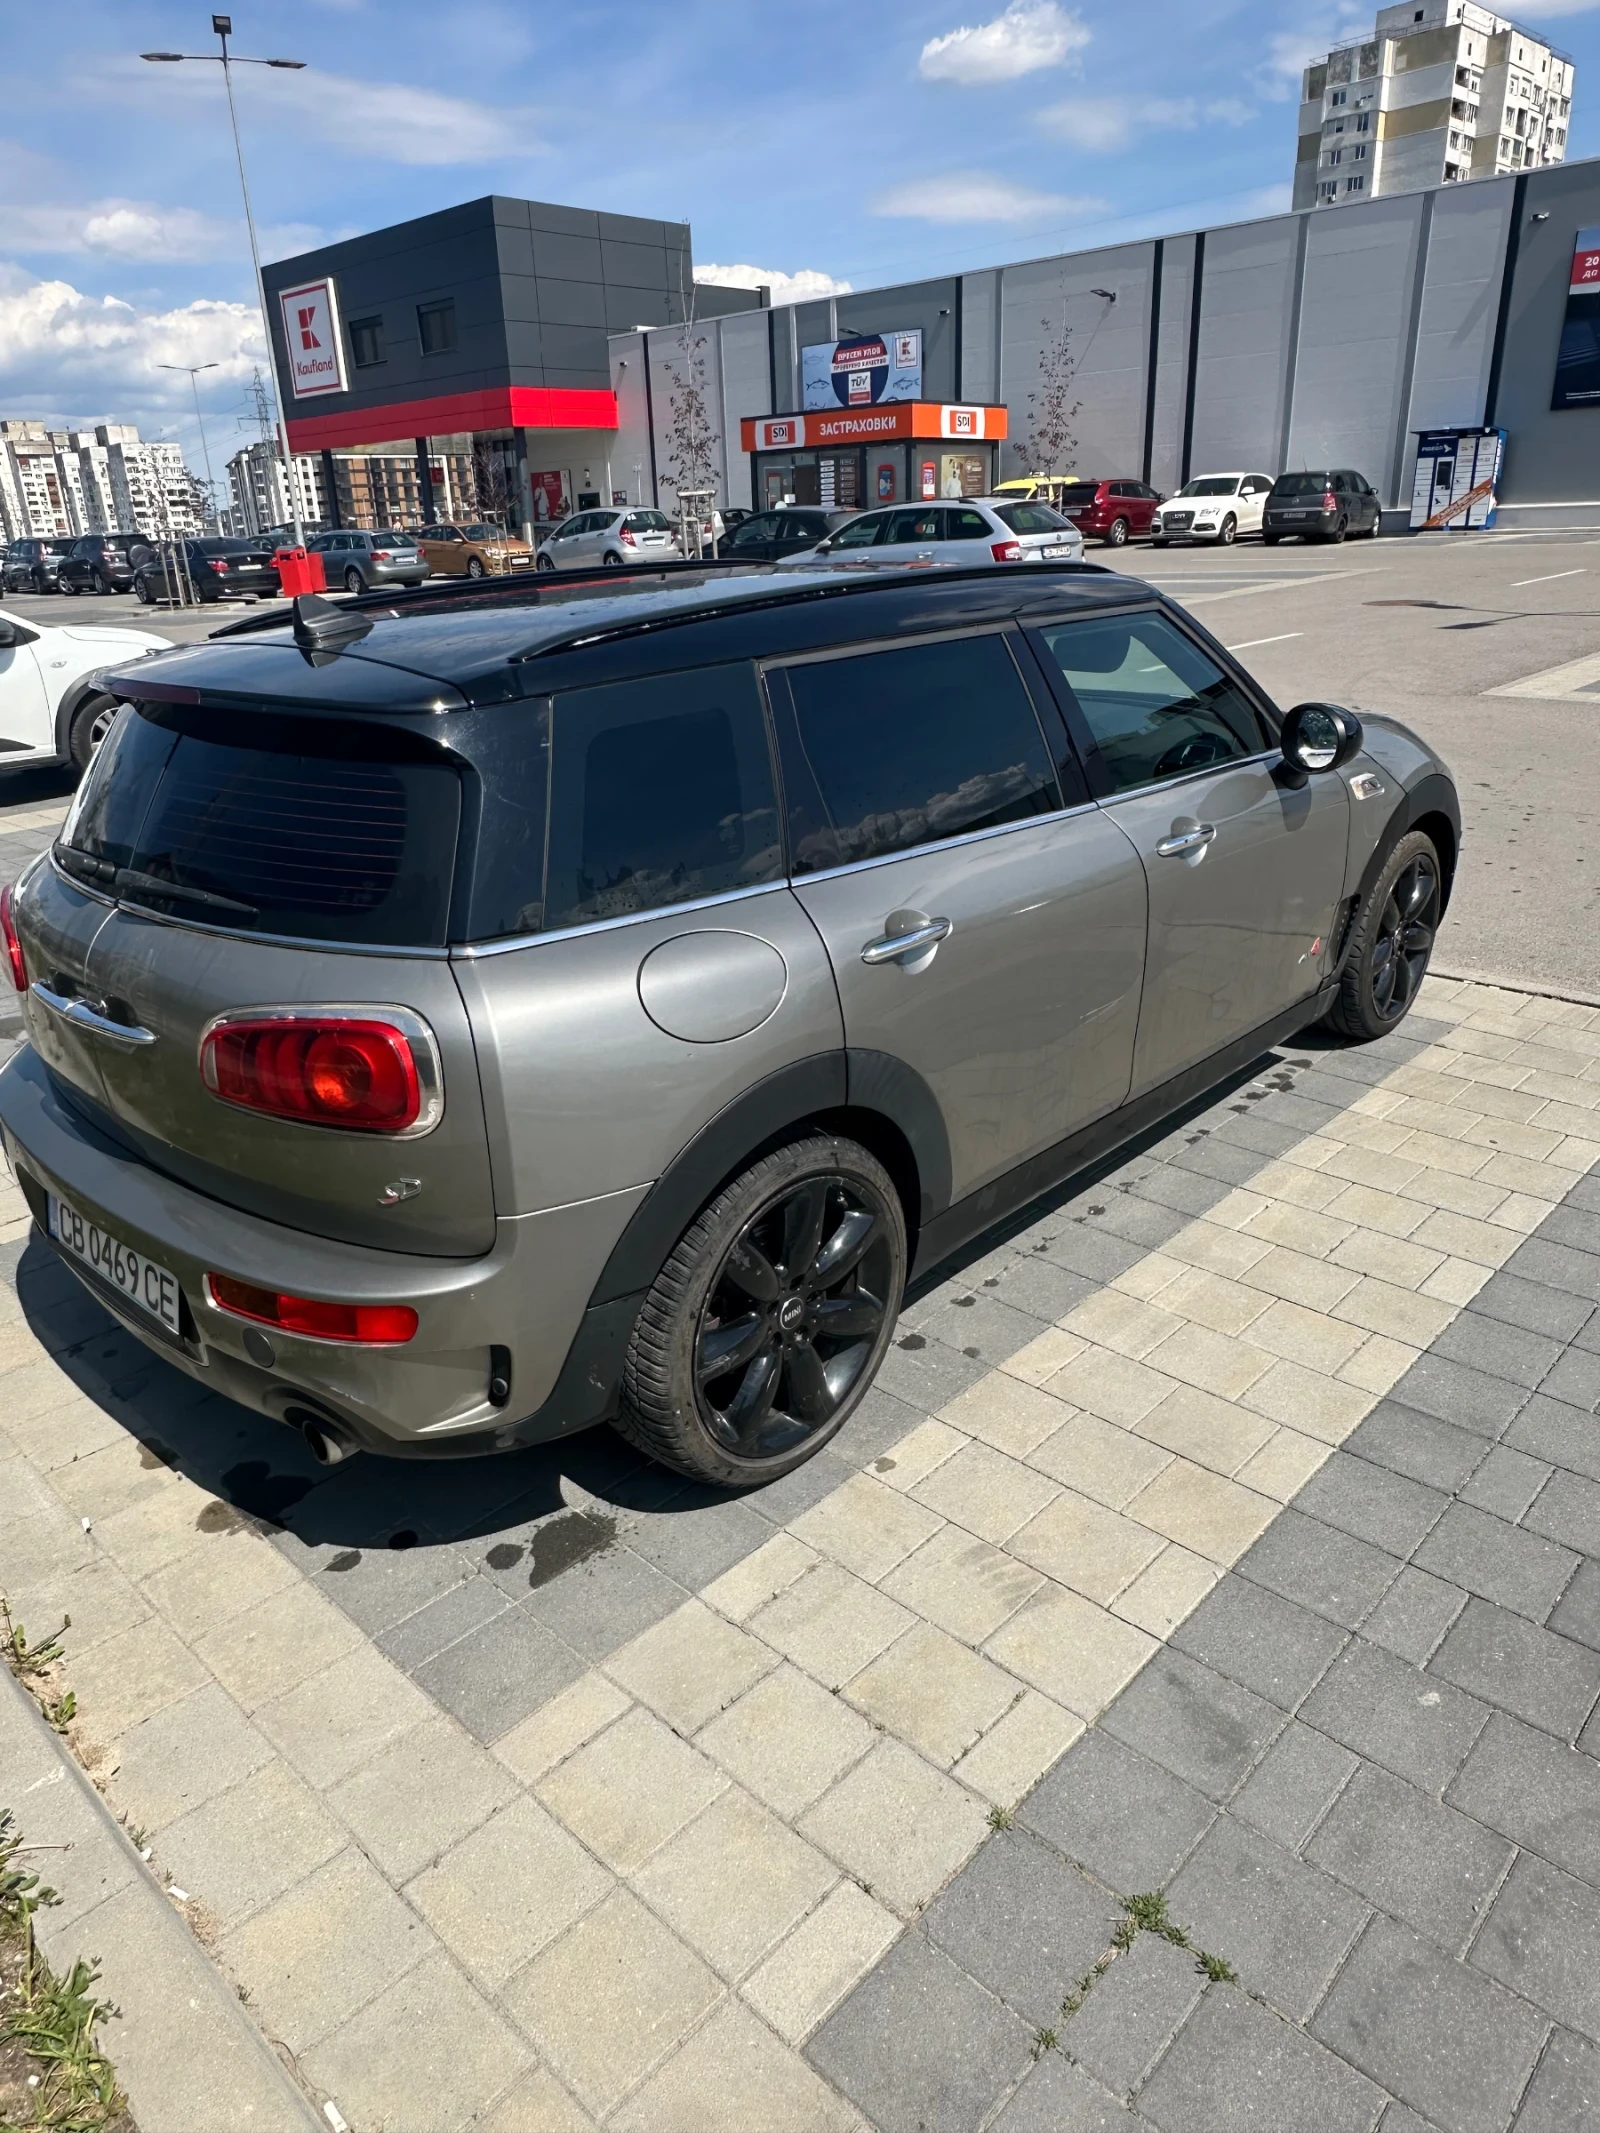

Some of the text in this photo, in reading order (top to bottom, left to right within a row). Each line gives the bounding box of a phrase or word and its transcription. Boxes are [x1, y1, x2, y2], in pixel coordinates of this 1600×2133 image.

[298, 305, 321, 350] K
[297, 356, 333, 376] Kaufland
[851, 375, 868, 387] TÜV
[819, 415, 896, 436] ЗАСТРАХОВКИ
[956, 414, 970, 427] SDI
[772, 426, 787, 438] SDI
[60, 1203, 174, 1325] CB 0469 CE
[784, 1305, 801, 1322] MINI
